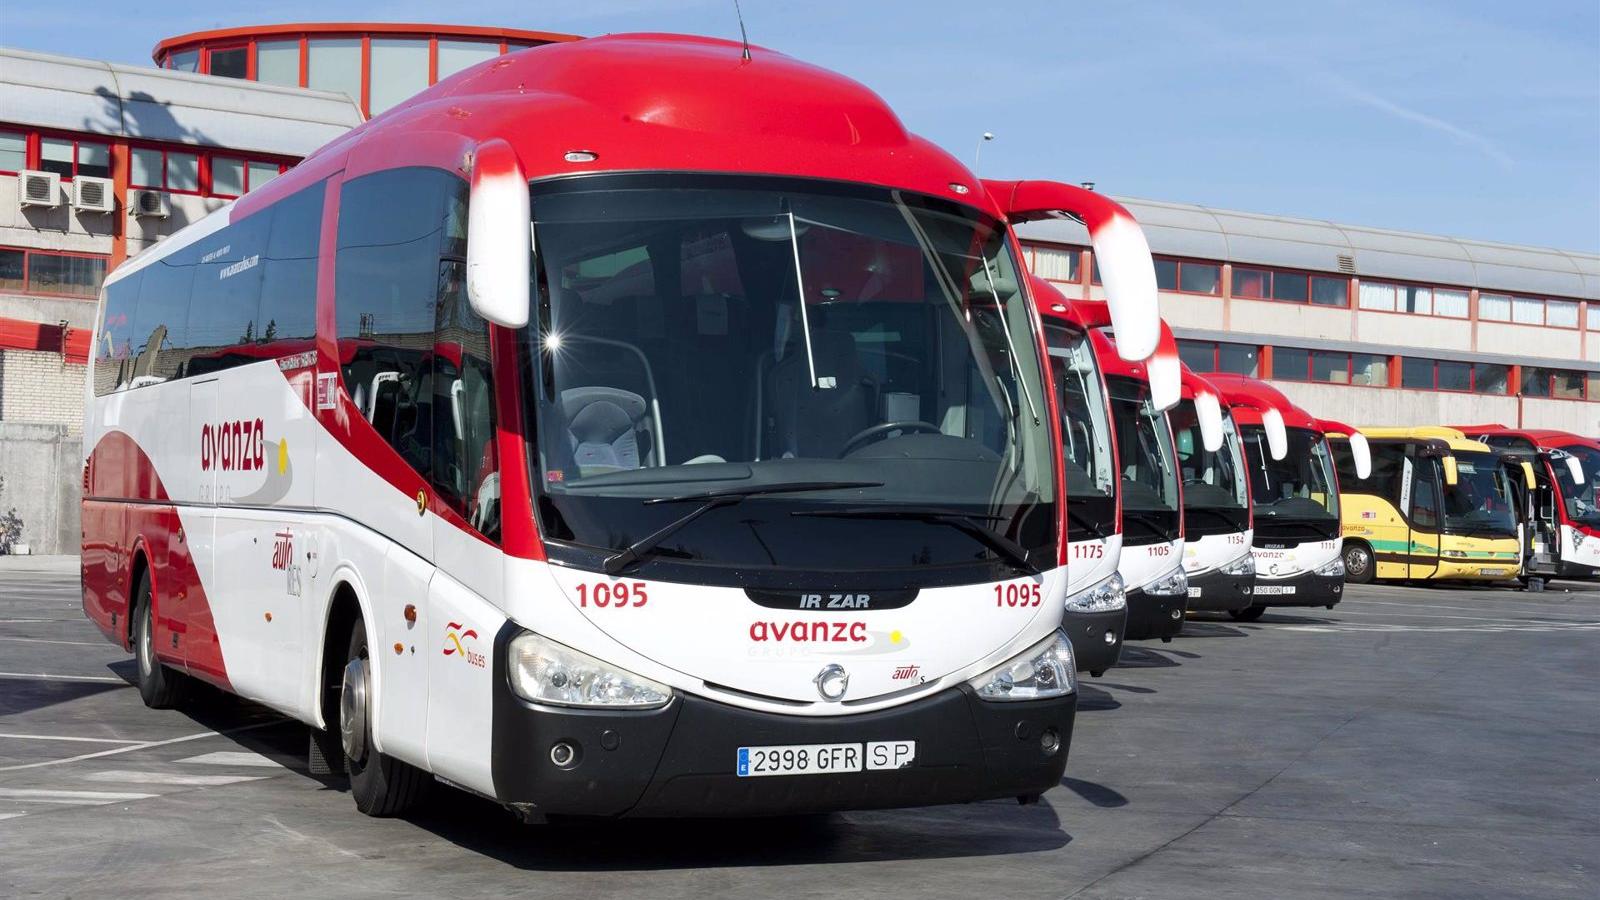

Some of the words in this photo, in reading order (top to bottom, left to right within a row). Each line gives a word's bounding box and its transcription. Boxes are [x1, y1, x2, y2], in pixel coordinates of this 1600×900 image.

[202, 418, 264, 471] avanza
[272, 527, 293, 571] auto
[1074, 544, 1103, 559] 1175
[1148, 546, 1169, 557] 1105
[1228, 536, 1244, 545] 1154
[575, 582, 648, 608] 1095
[994, 583, 1042, 608] 1095
[749, 620, 867, 642] avanza
[892, 664, 920, 680] auto
[740, 764, 747, 772] E
[754, 749, 809, 772] 2998
[817, 747, 857, 770] GFR
